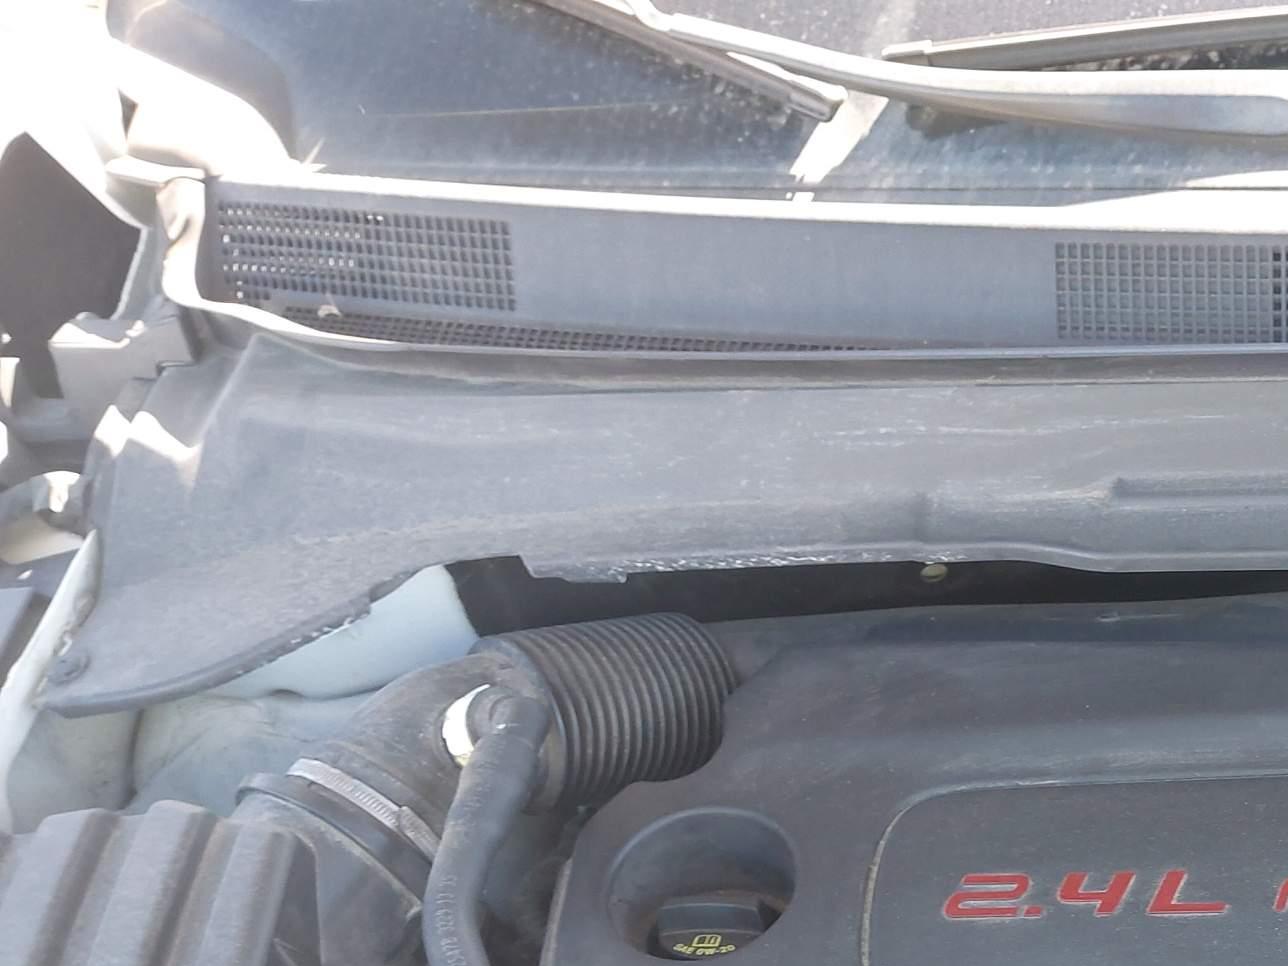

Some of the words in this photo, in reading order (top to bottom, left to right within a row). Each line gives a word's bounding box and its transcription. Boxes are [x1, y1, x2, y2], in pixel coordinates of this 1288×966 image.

[943, 868, 1228, 919] 2.4L
[673, 943, 696, 954] SAE
[695, 944, 736, 956] 0W-20
